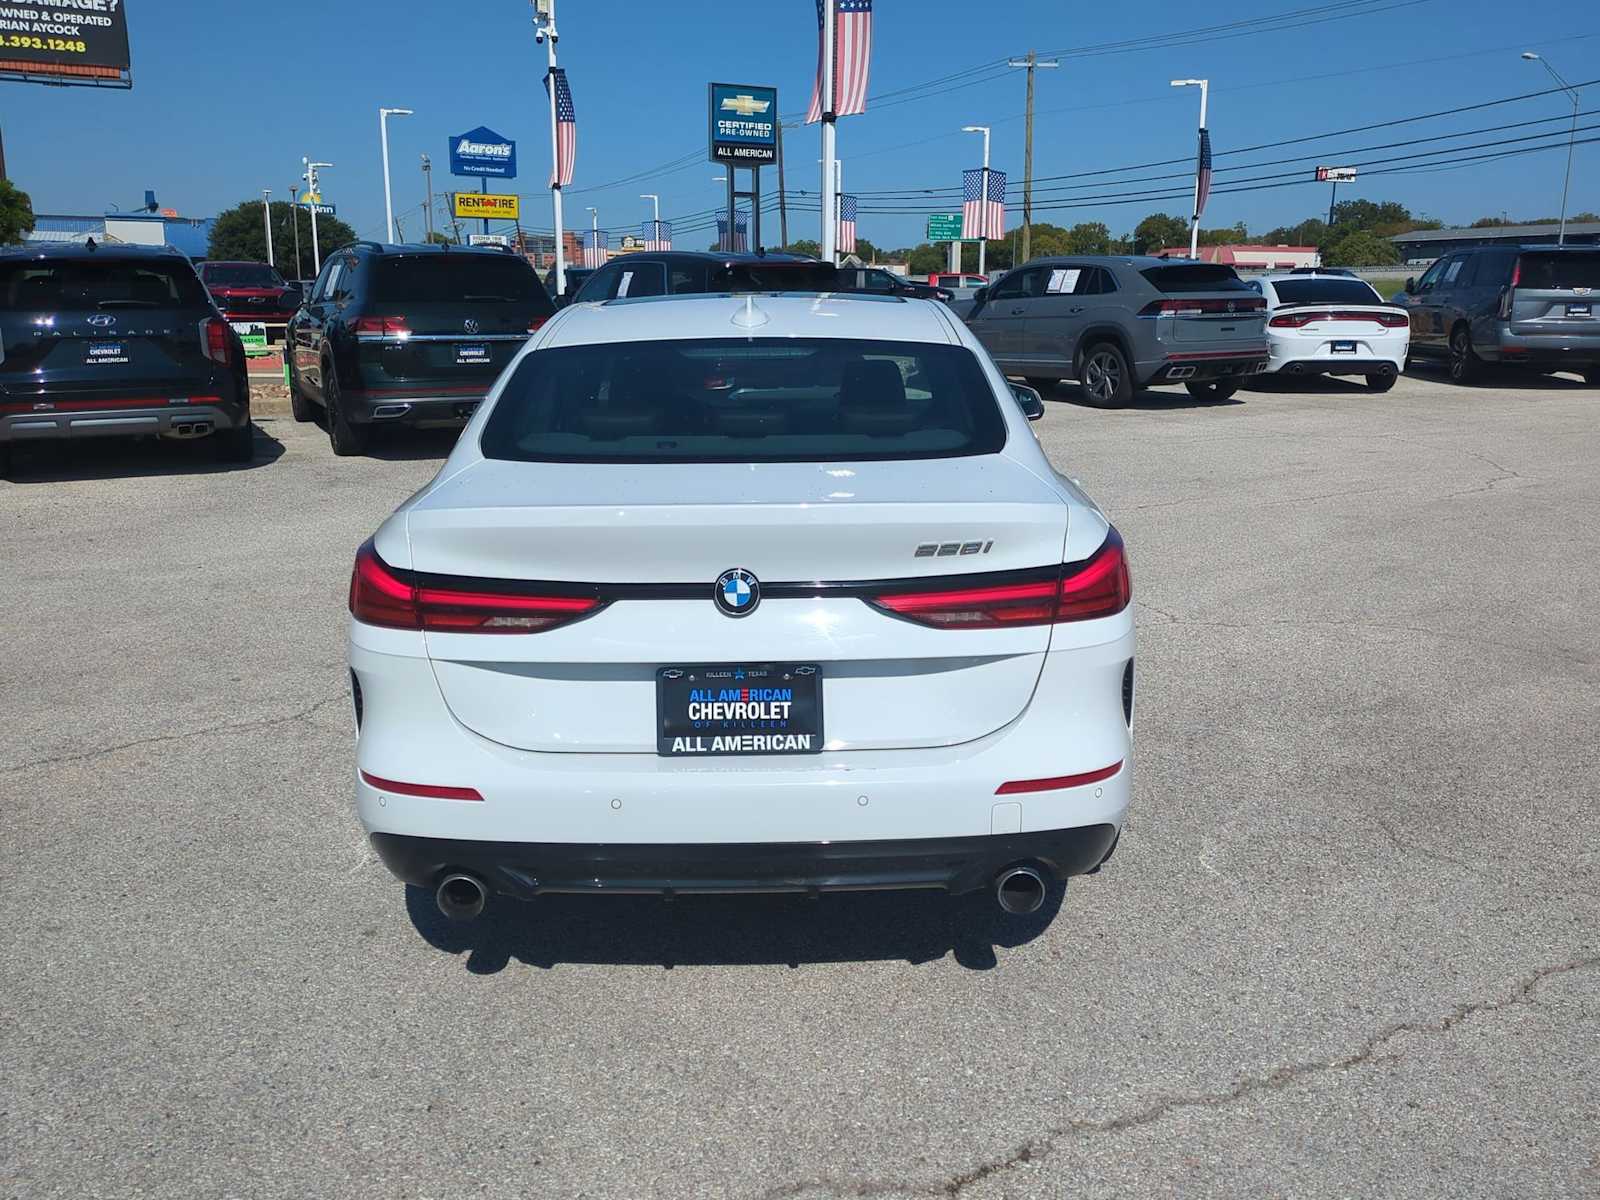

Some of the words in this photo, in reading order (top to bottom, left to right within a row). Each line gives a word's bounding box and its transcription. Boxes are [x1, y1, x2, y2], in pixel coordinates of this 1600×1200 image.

[0, 8, 39, 20] WNED
[41, 11, 51, 21] &
[53, 12, 113, 27] OPERATED
[32, 23, 80, 36] AYCOCK
[718, 120, 772, 130] CERTIFIED
[720, 128, 770, 137] PRE-OWNED
[456, 139, 512, 157] Aaron's
[718, 147, 732, 156] ALL
[734, 148, 773, 159] AMERICAN
[459, 197, 486, 208] RENT
[492, 199, 515, 209] TIRE
[720, 571, 757, 587] BMW
[689, 689, 716, 702] ALL
[719, 688, 792, 703] AMERICAN
[688, 702, 792, 720] CHEVROLET
[694, 720, 711, 729] OF
[723, 720, 787, 729] KILLEEN
[672, 736, 707, 753] ALL
[712, 734, 811, 752] AMERICAN
